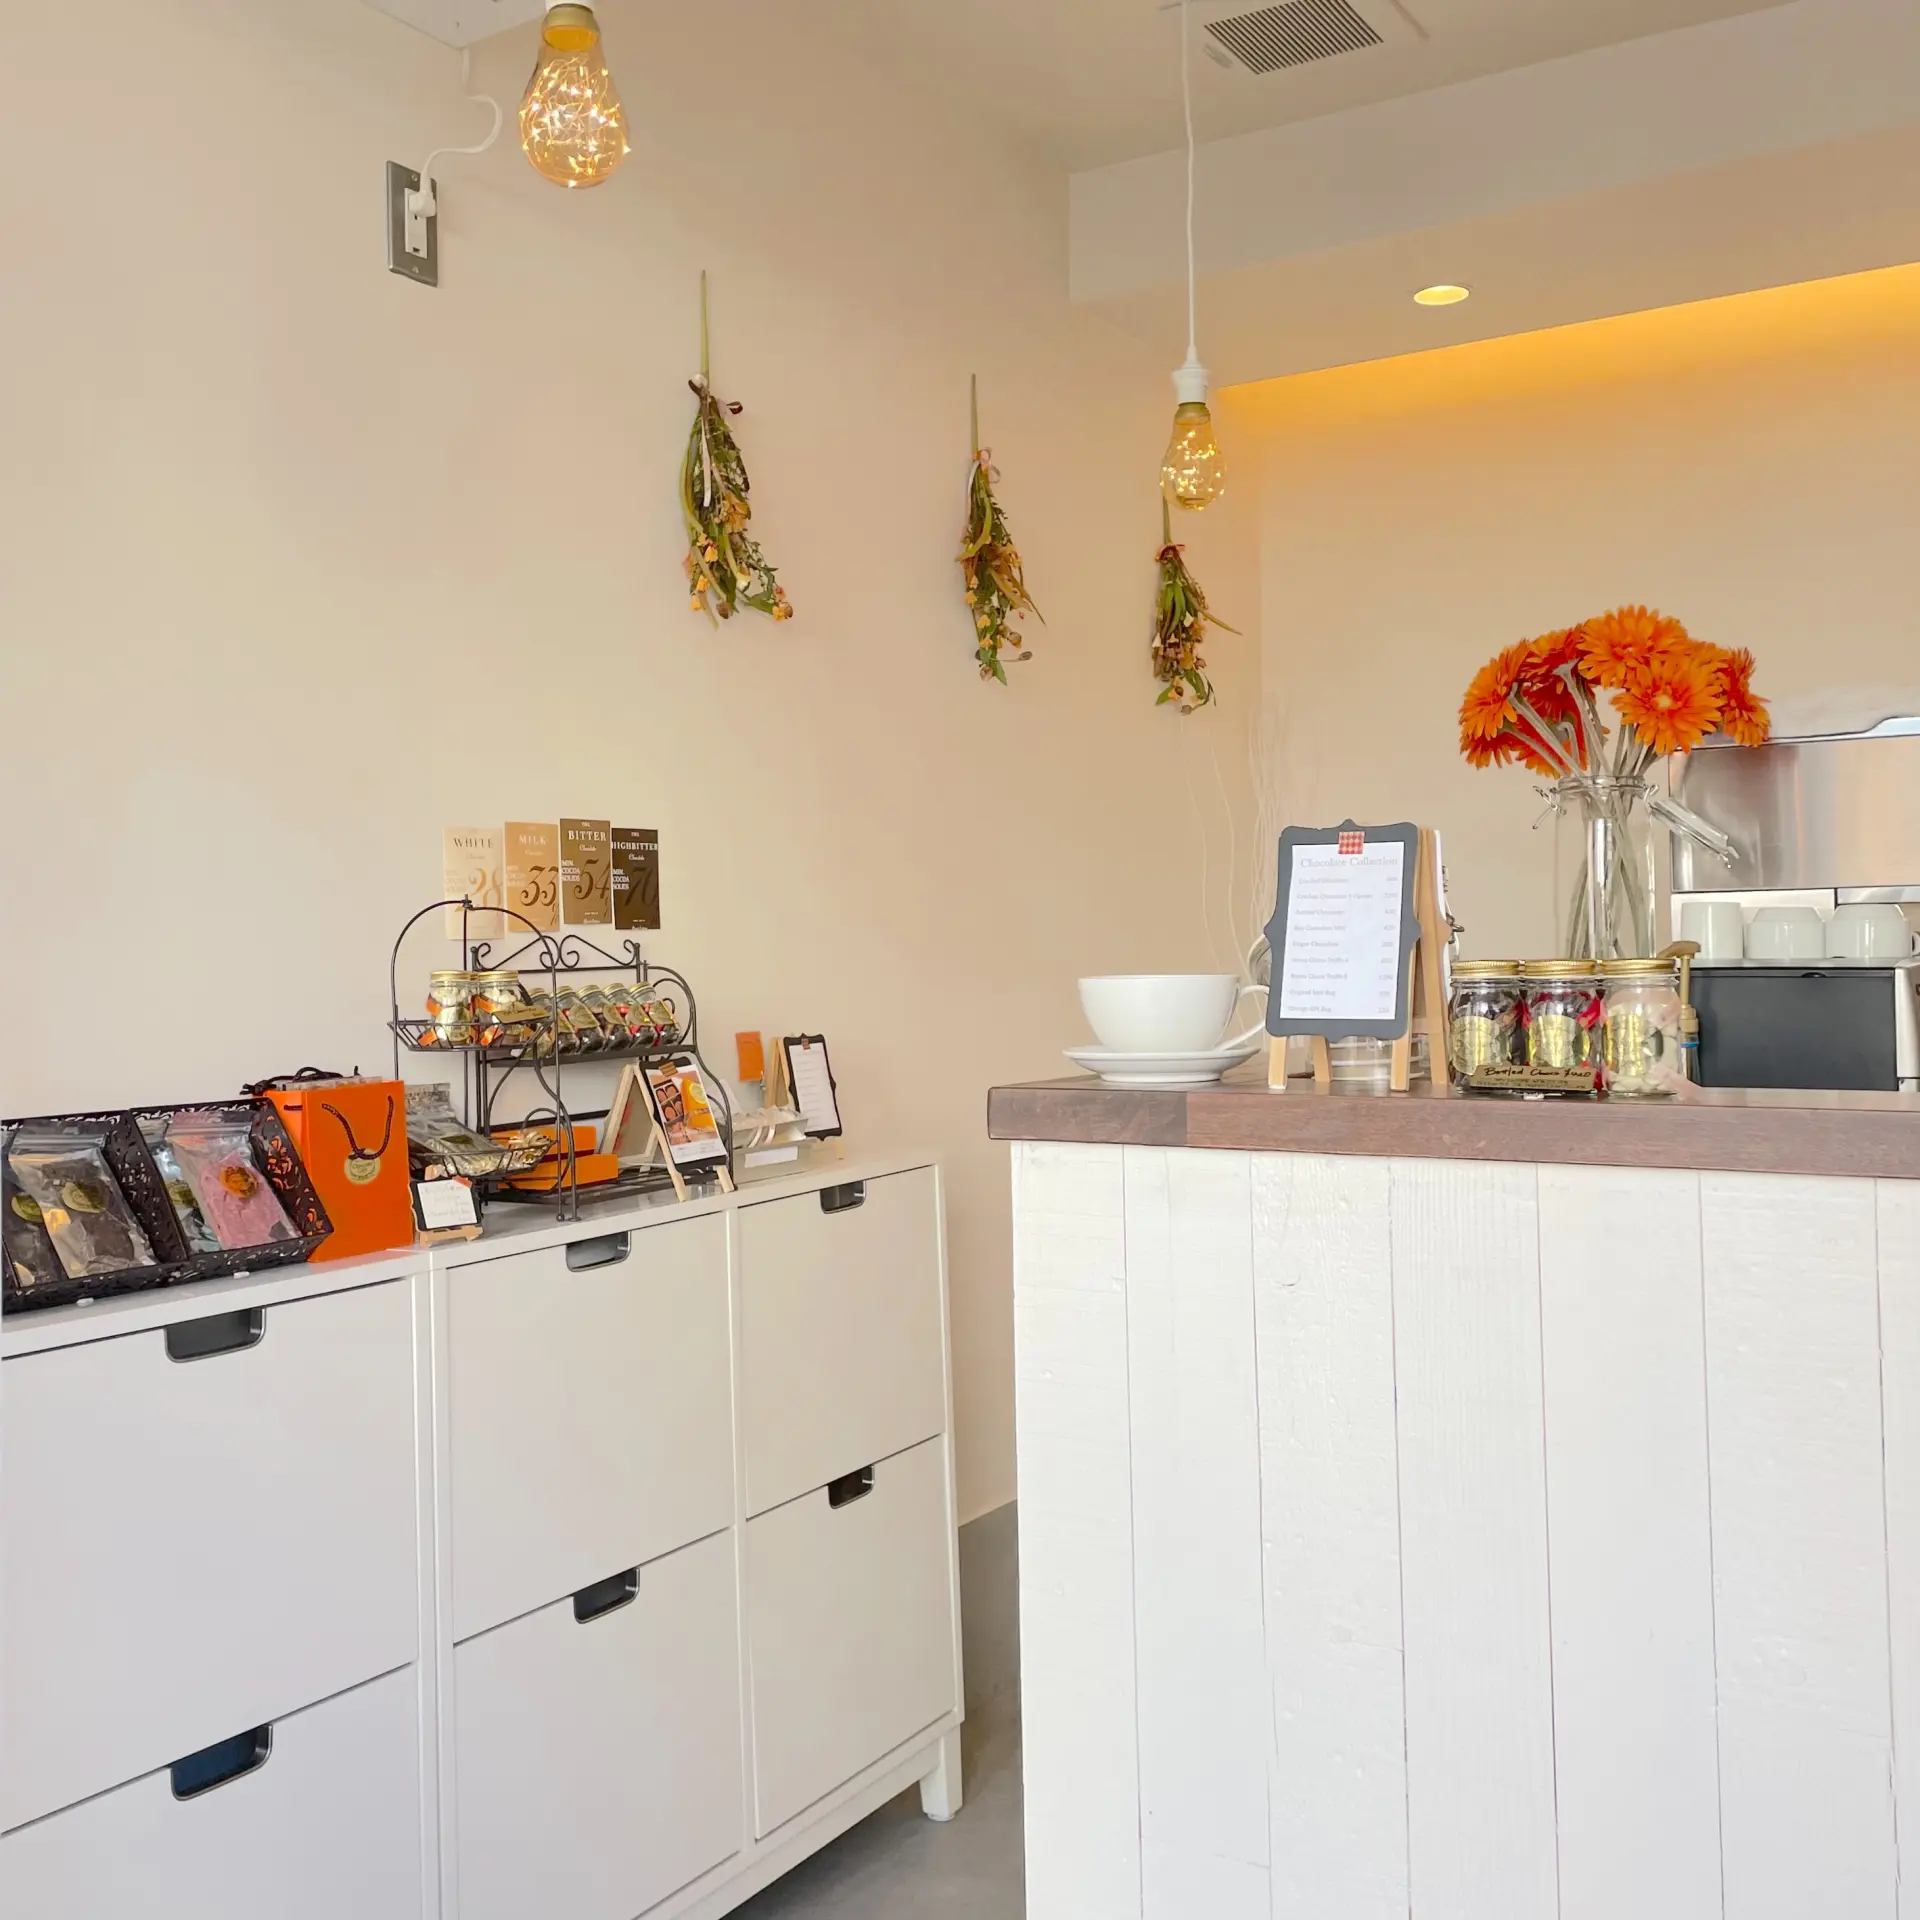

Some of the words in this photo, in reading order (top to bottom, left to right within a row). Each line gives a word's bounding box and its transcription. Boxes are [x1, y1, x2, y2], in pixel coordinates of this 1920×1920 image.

[518, 834, 548, 846] MILK
[568, 830, 607, 842] BITTER
[453, 837, 494, 849] WHITE
[1300, 857, 1347, 868] Chocolate
[1349, 856, 1398, 867] Collection
